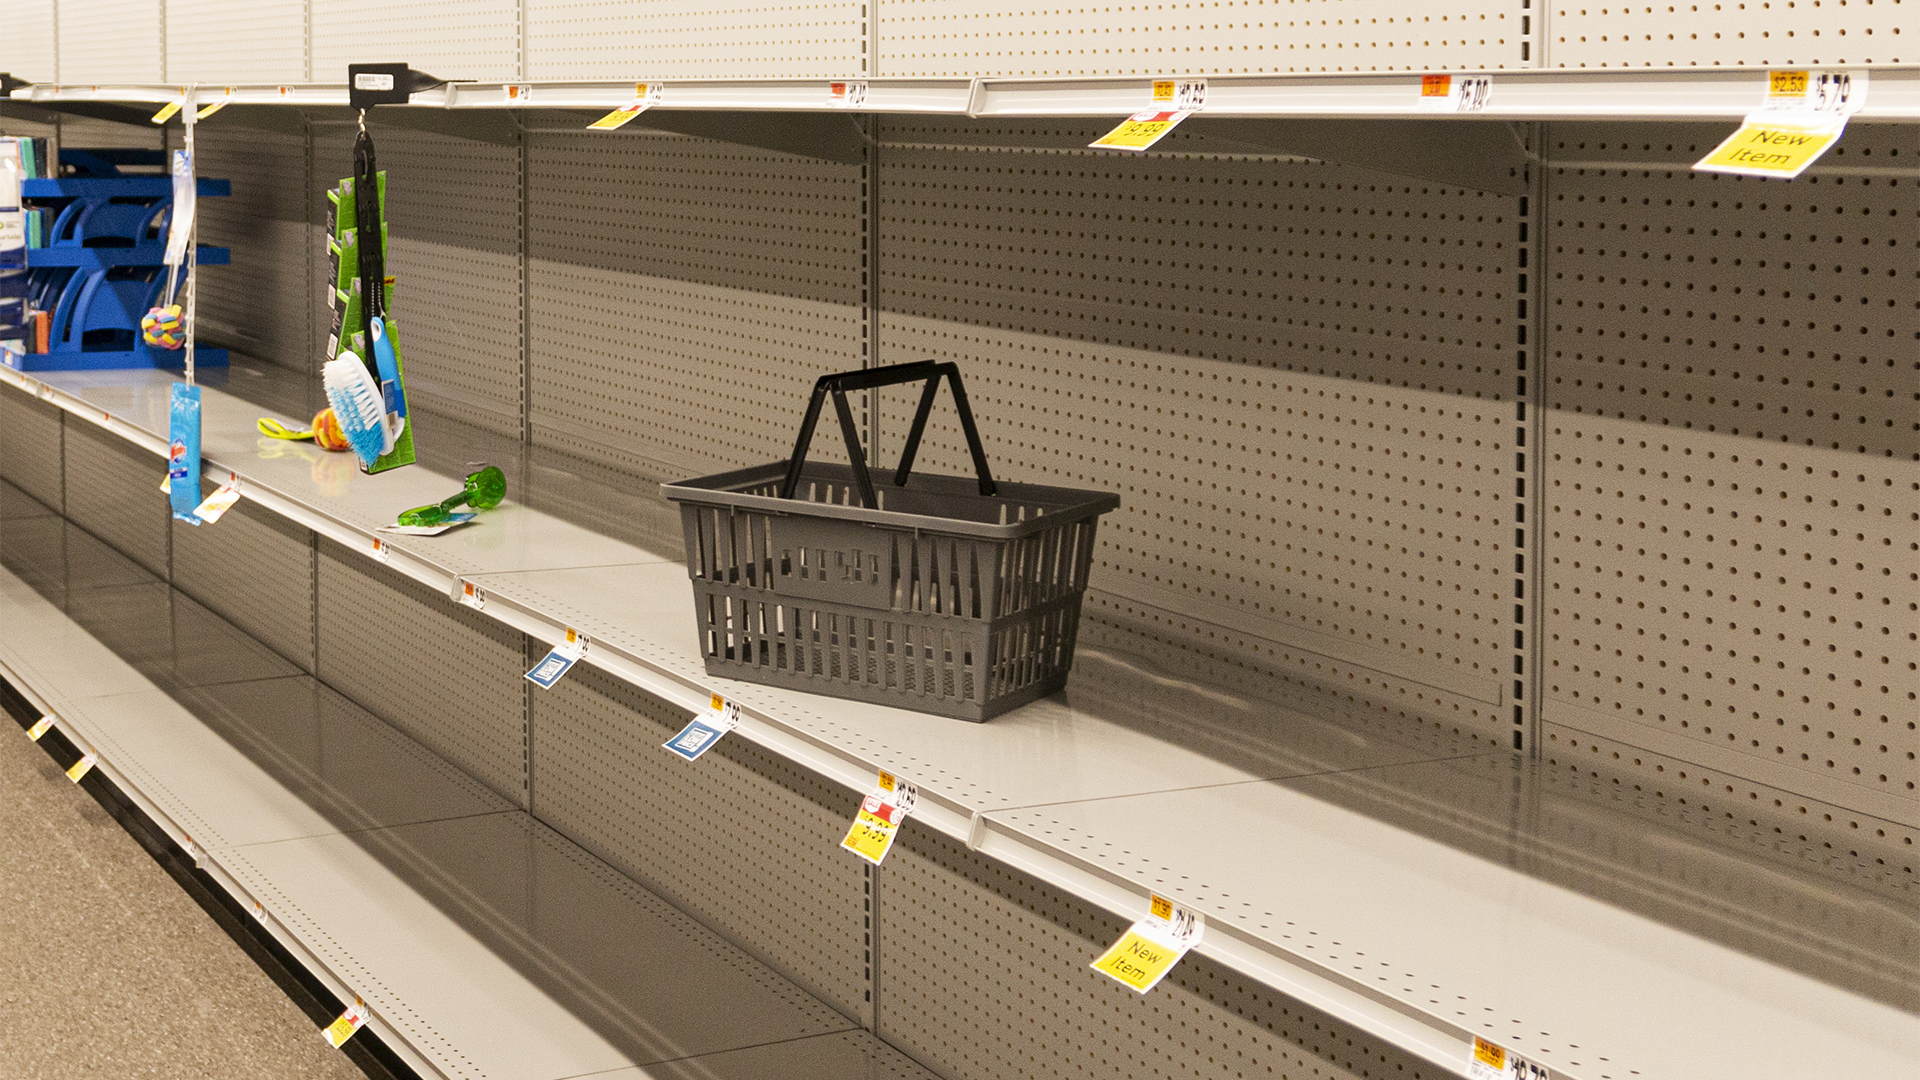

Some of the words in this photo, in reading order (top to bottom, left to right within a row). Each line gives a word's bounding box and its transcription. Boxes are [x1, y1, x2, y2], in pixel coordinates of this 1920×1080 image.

[1750, 130, 1814, 147] New
[1727, 147, 1791, 165] Item
[1126, 940, 1164, 964] New
[1110, 955, 1147, 981] Item
